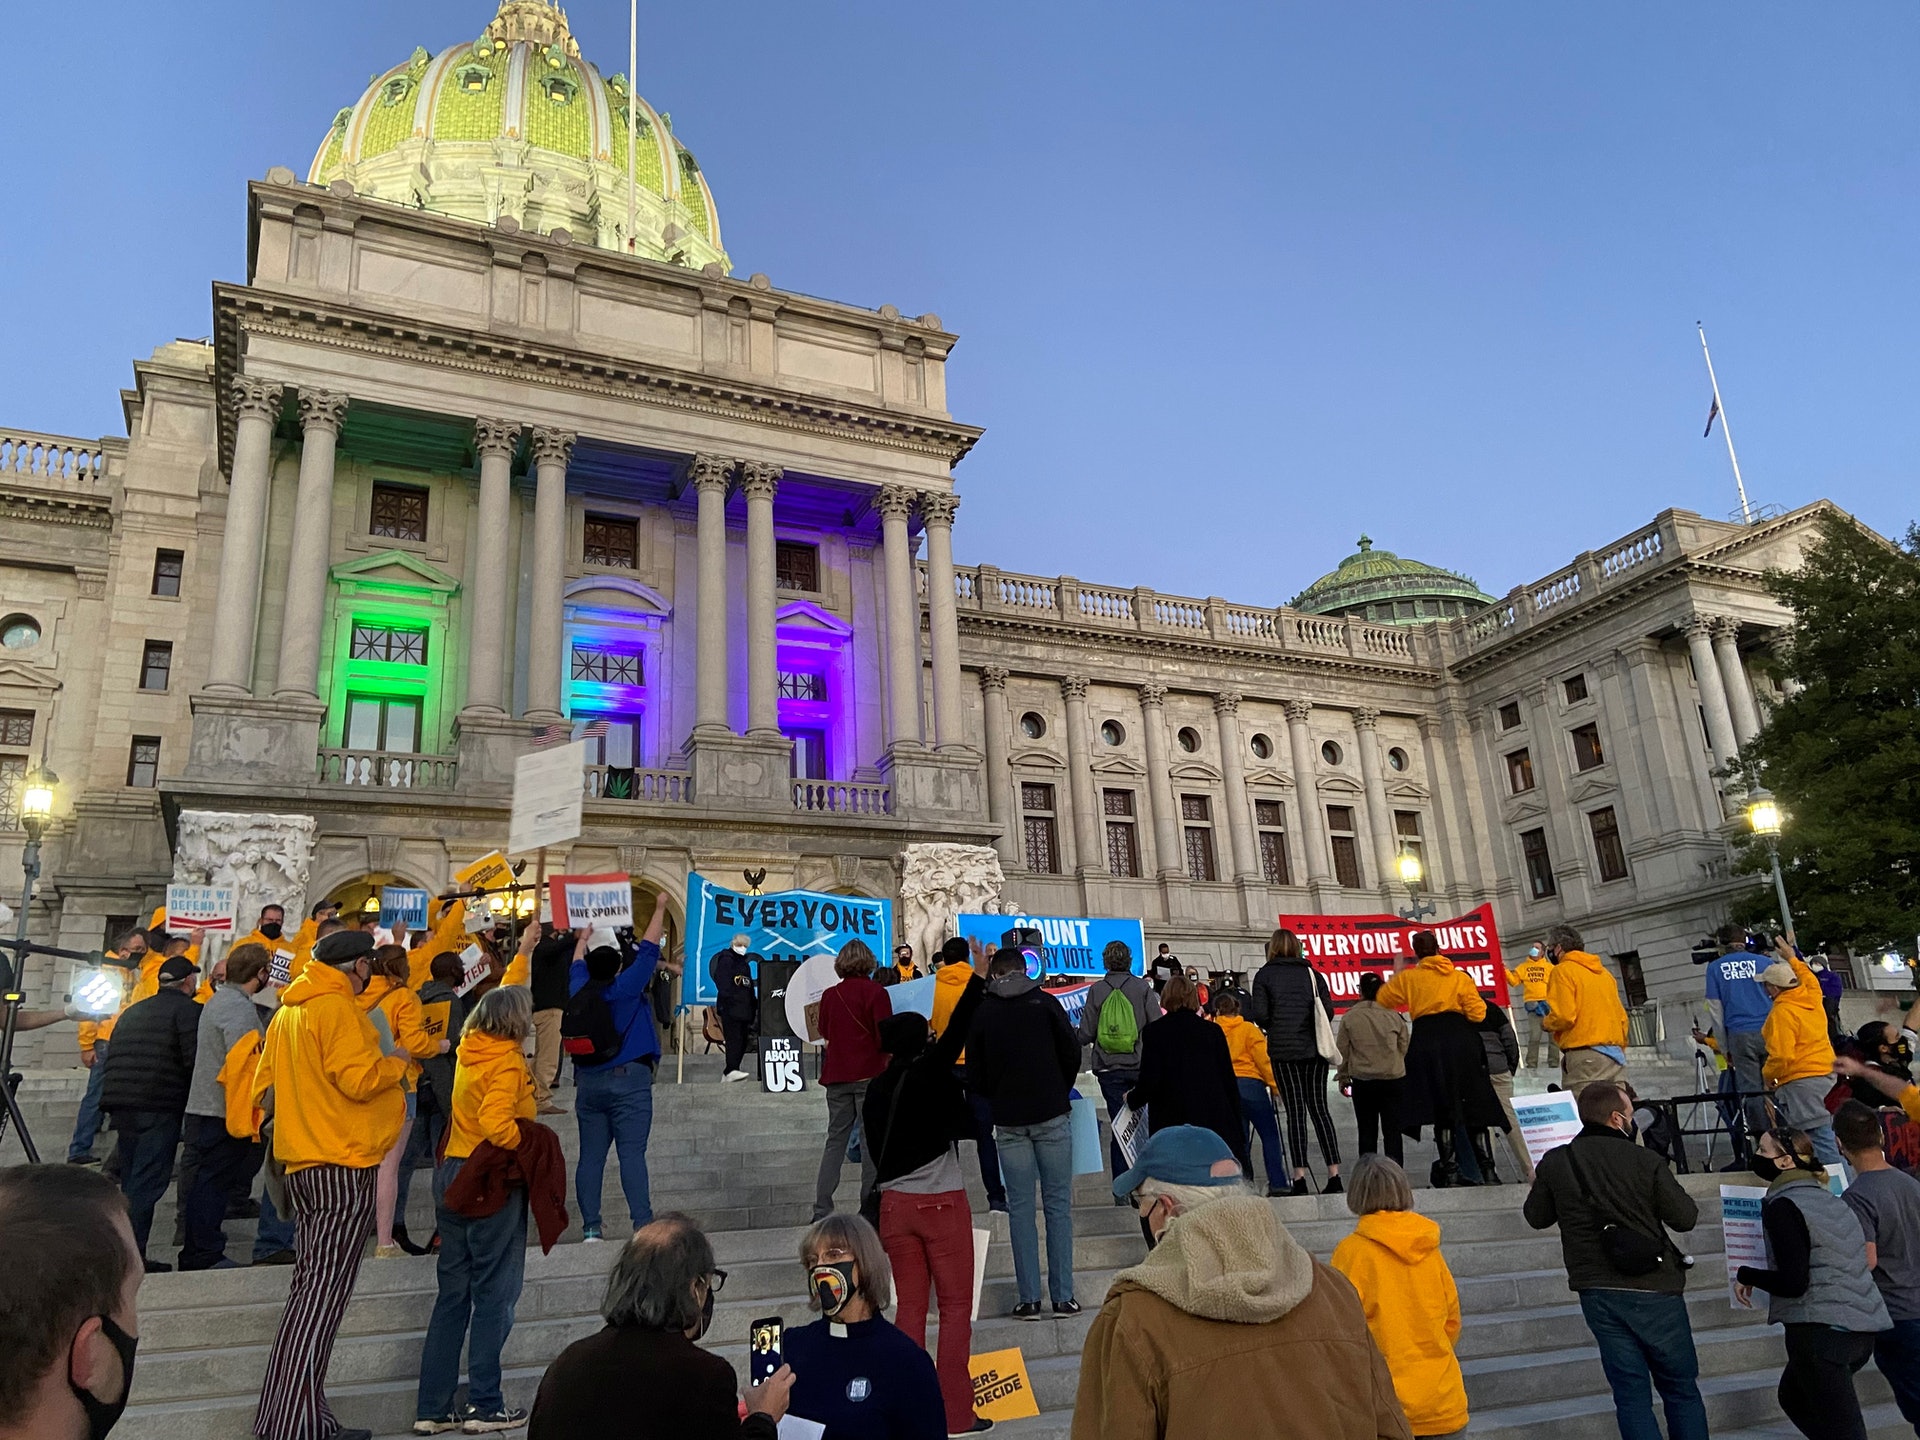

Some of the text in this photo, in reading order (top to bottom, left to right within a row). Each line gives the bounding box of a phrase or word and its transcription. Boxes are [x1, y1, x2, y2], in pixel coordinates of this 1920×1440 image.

[171, 889, 232, 900] ONLY IF WE
[568, 890, 628, 907] THE PEOPLE
[171, 900, 231, 911] DEFEND IT
[570, 905, 629, 918] HAVE SPOKEN
[715, 894, 878, 936] EVERYONE
[1298, 925, 1488, 957] EVERYONE CUNTS
[1061, 947, 1095, 969] VOTE
[1723, 968, 1756, 980] CREW
[771, 1038, 790, 1050] IT'S
[765, 1050, 800, 1062] ABOUT
[765, 1061, 803, 1092] US
[975, 1378, 1023, 1407] DECIDE
